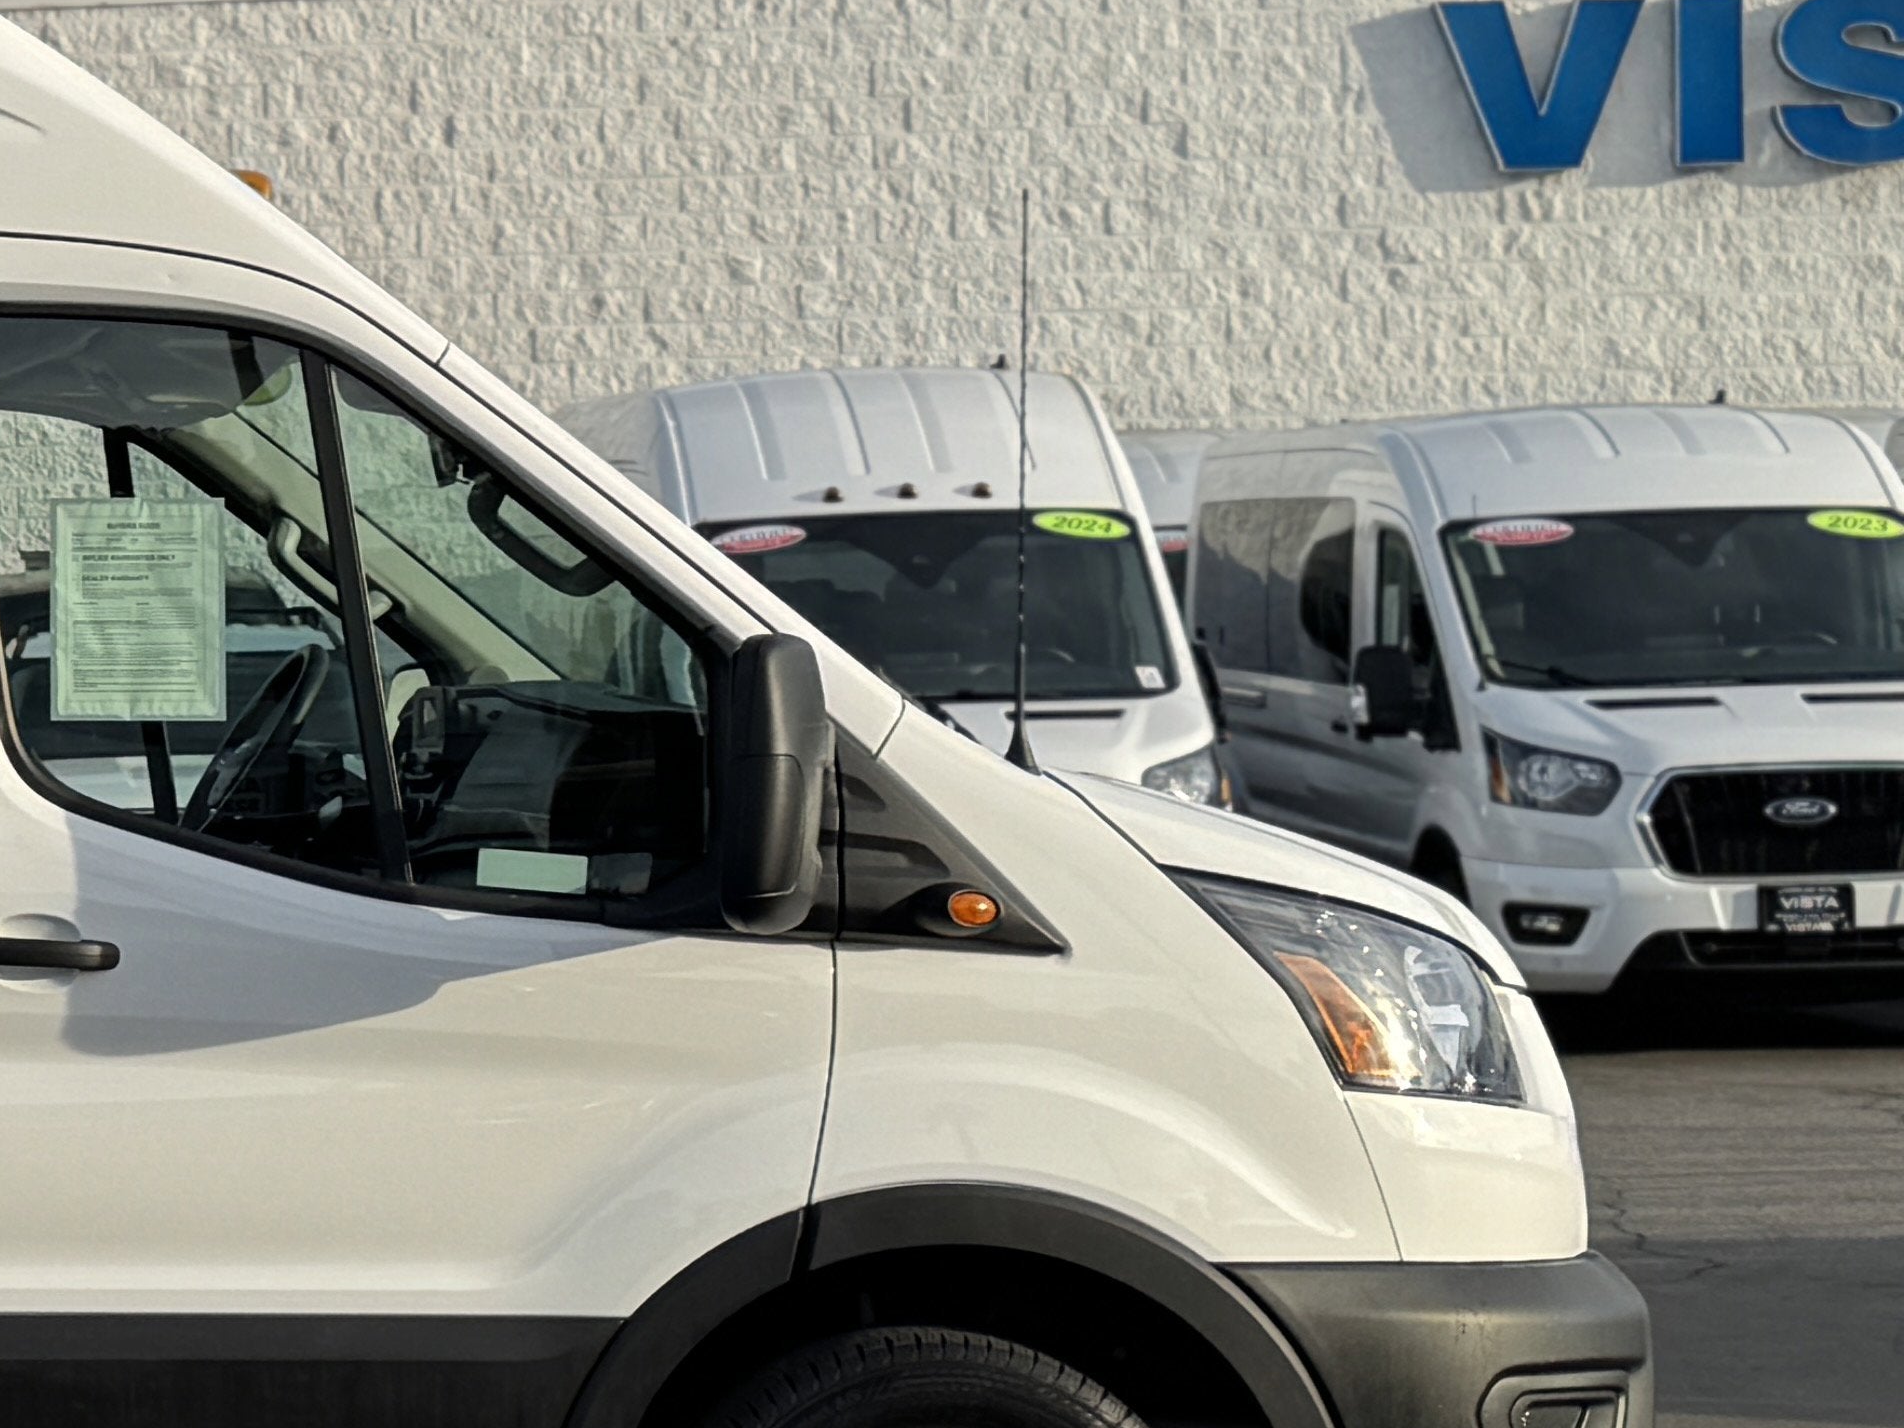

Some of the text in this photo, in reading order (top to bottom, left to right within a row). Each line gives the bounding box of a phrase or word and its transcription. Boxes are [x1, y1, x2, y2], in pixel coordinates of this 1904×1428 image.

[1052, 515, 1112, 533] 2024
[1828, 515, 1889, 532] 2023
[1780, 896, 1839, 909] VISTA
